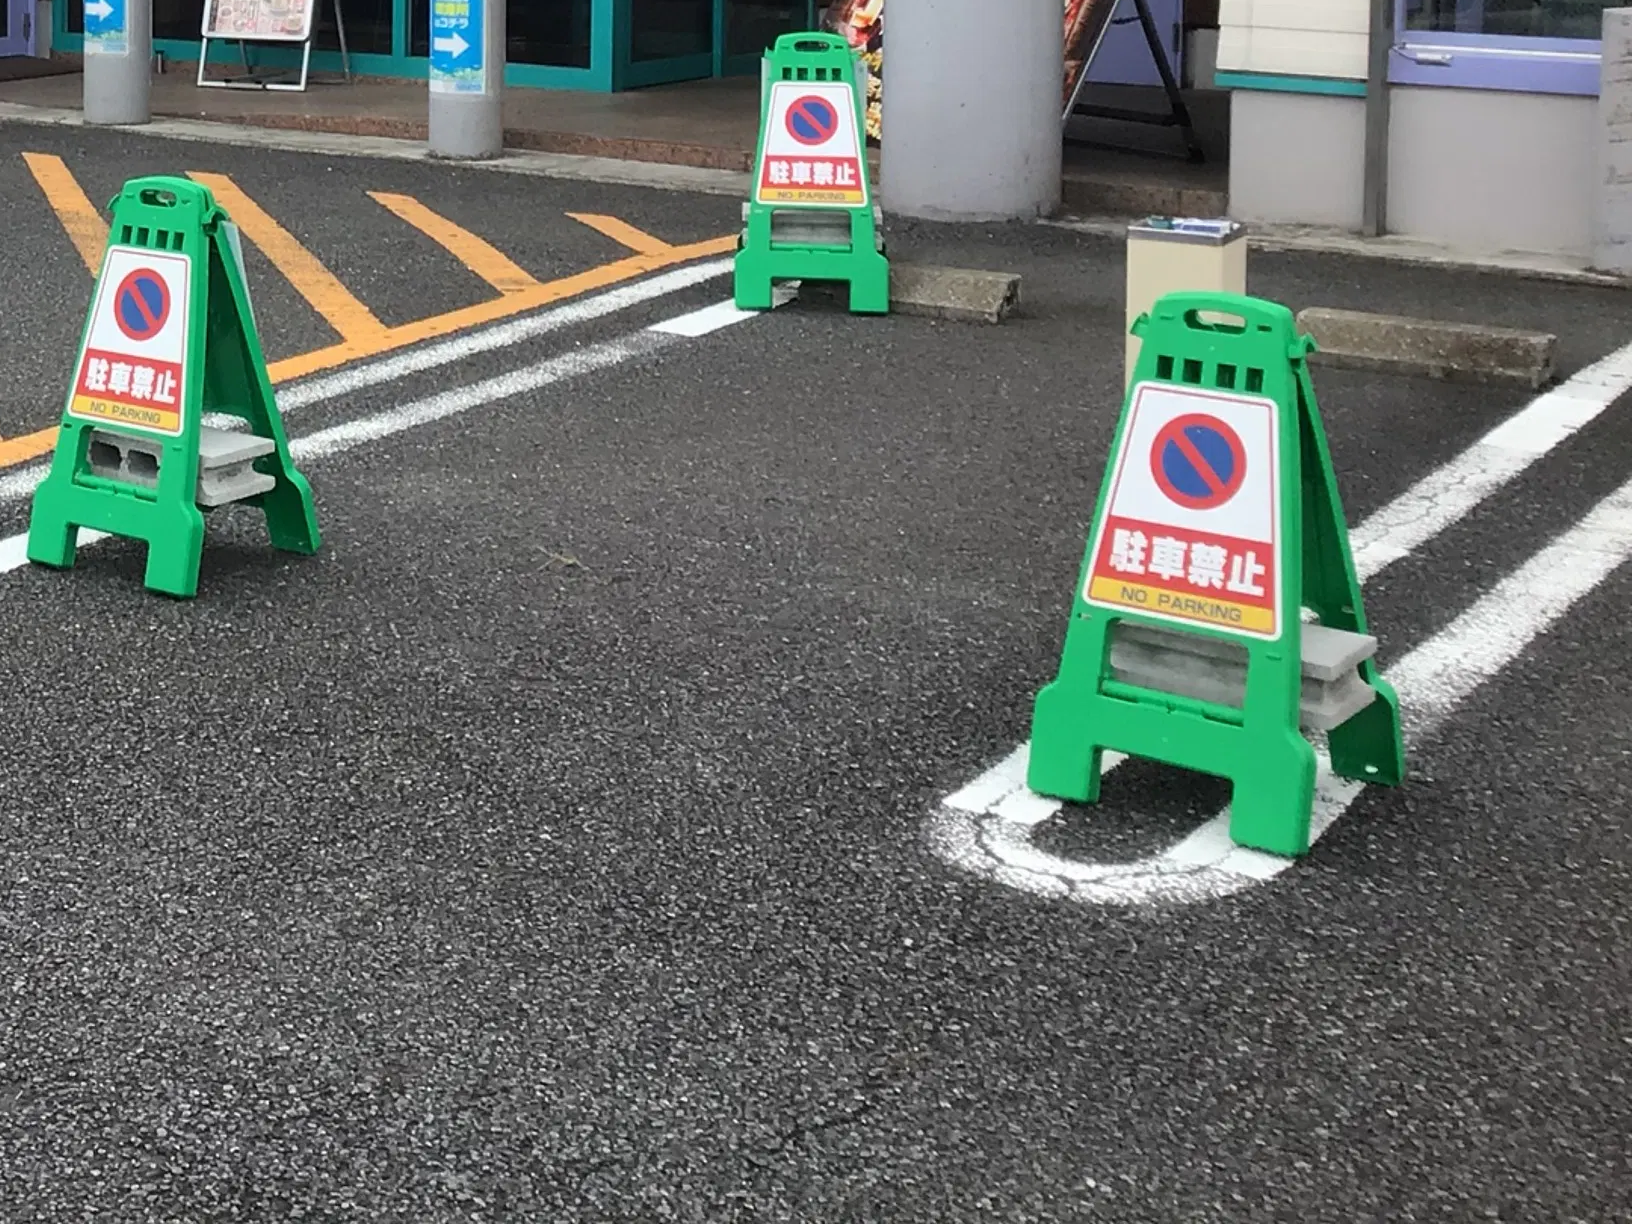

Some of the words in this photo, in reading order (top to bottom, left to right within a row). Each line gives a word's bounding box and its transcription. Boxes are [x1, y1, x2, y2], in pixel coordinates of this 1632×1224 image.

[768, 160, 856, 186] 駐車禁止
[777, 191, 793, 199] NO
[798, 192, 846, 201] PARKING
[84, 357, 177, 405] 駐車禁止
[89, 401, 108, 414] NO
[111, 405, 162, 424] PARKING
[1108, 527, 1266, 598] 駐車禁止
[1120, 585, 1148, 604] NO
[1157, 593, 1243, 622] PARKING
